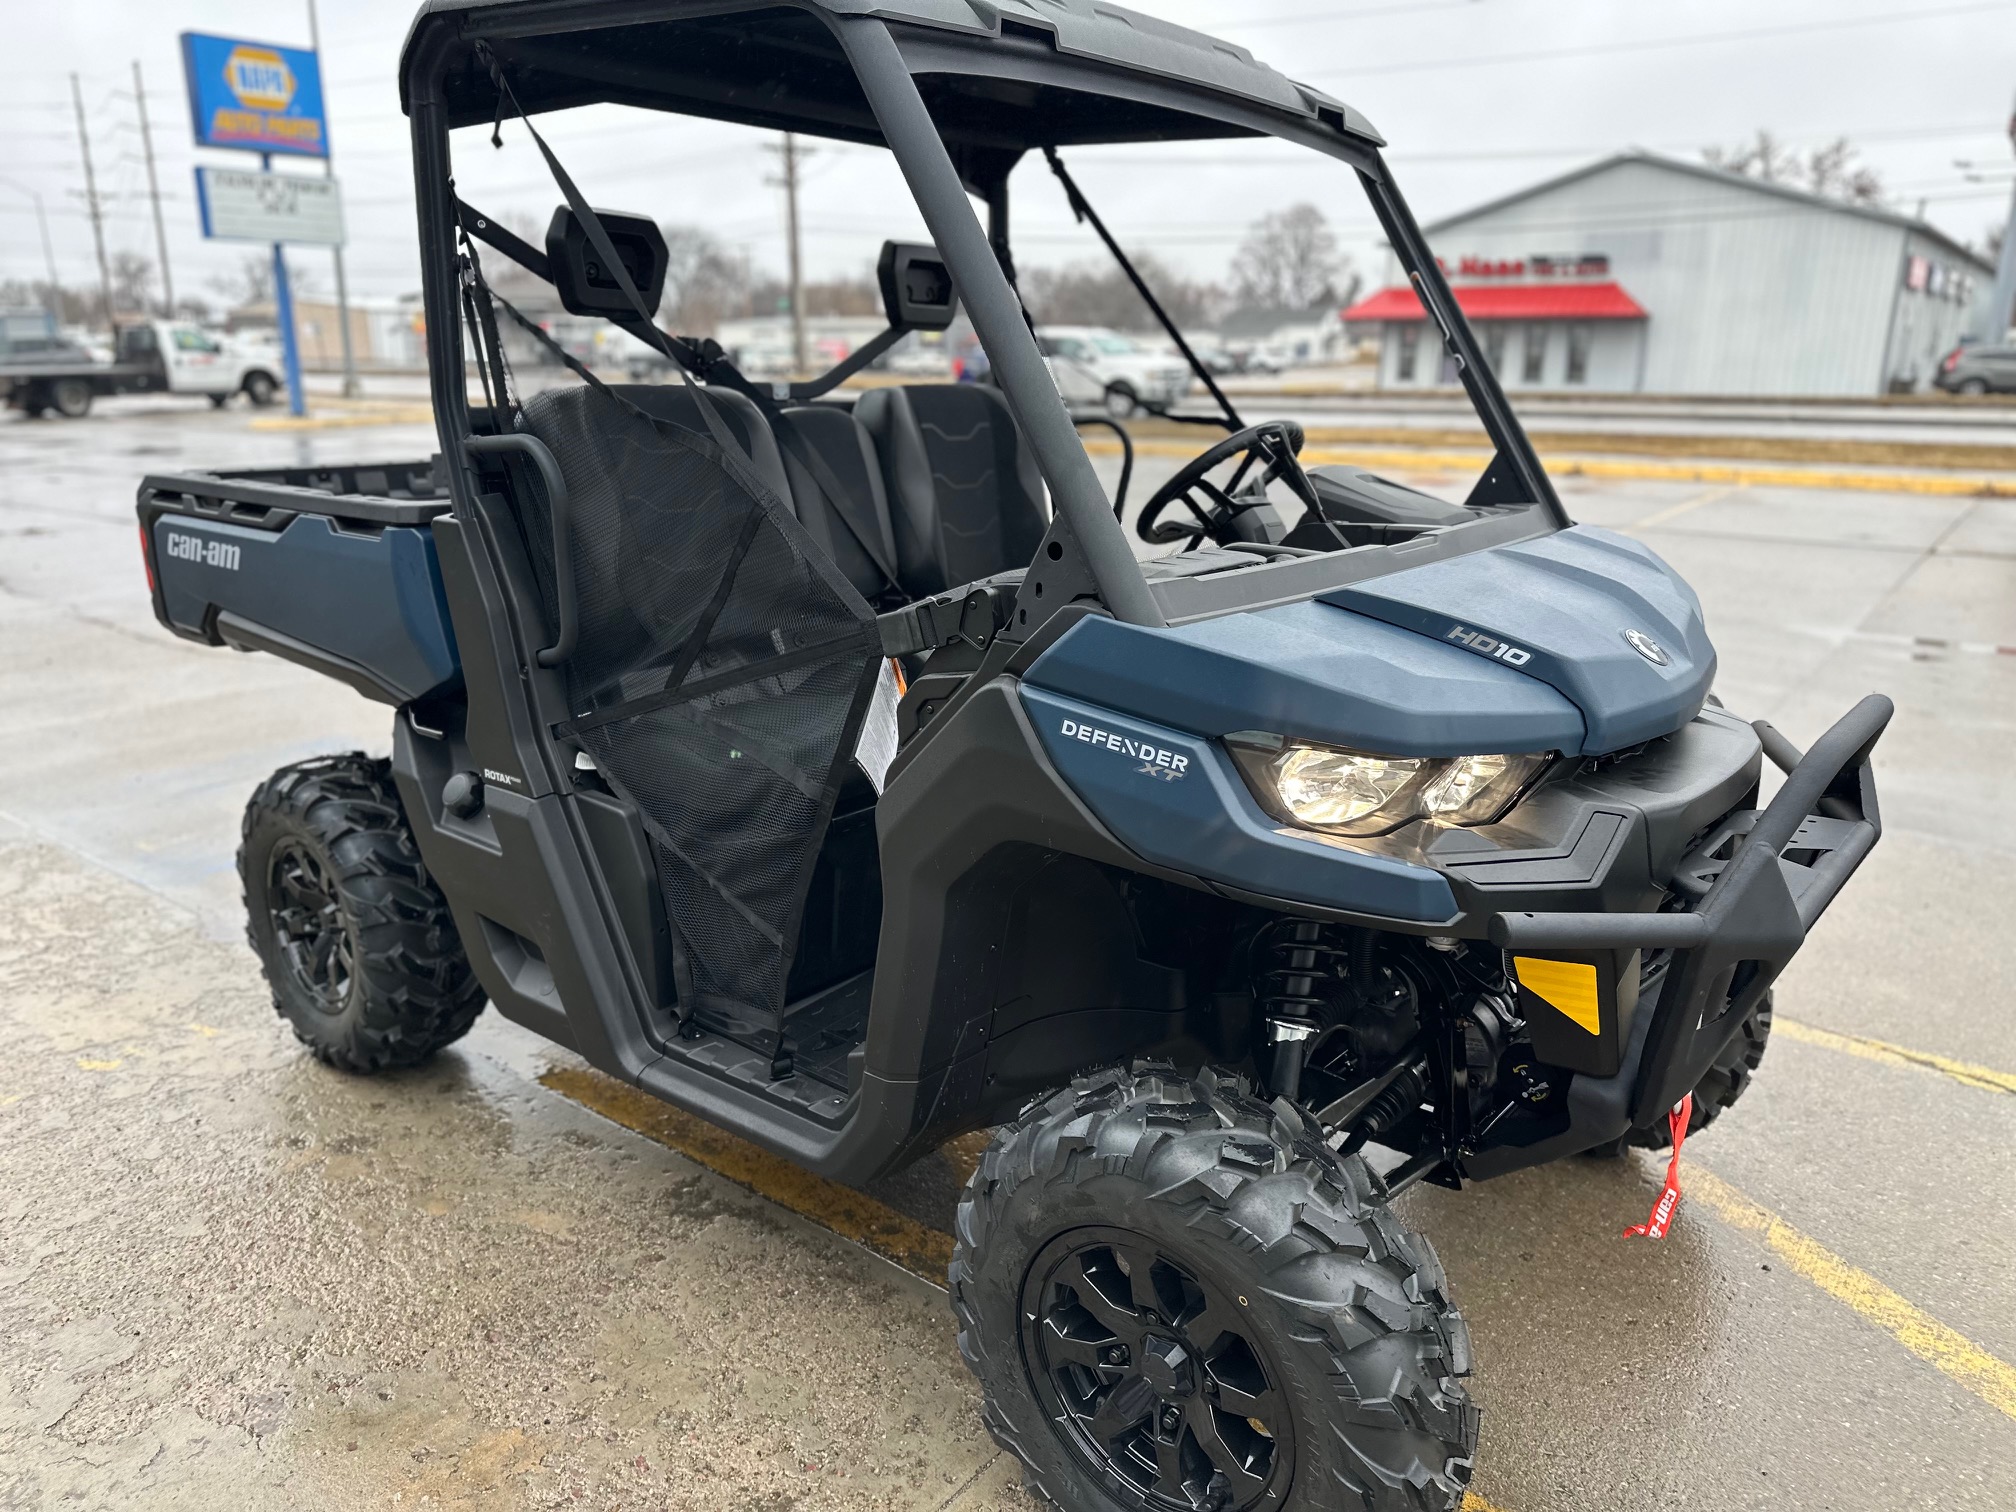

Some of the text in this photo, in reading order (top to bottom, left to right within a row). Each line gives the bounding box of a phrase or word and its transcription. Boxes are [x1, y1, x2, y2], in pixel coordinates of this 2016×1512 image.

[167, 532, 241, 571] can-am
[1447, 626, 1531, 666] HD10
[1061, 719, 1189, 772] DEFENDER
[484, 768, 511, 785] ROTAX
[1138, 762, 1184, 781] XT
